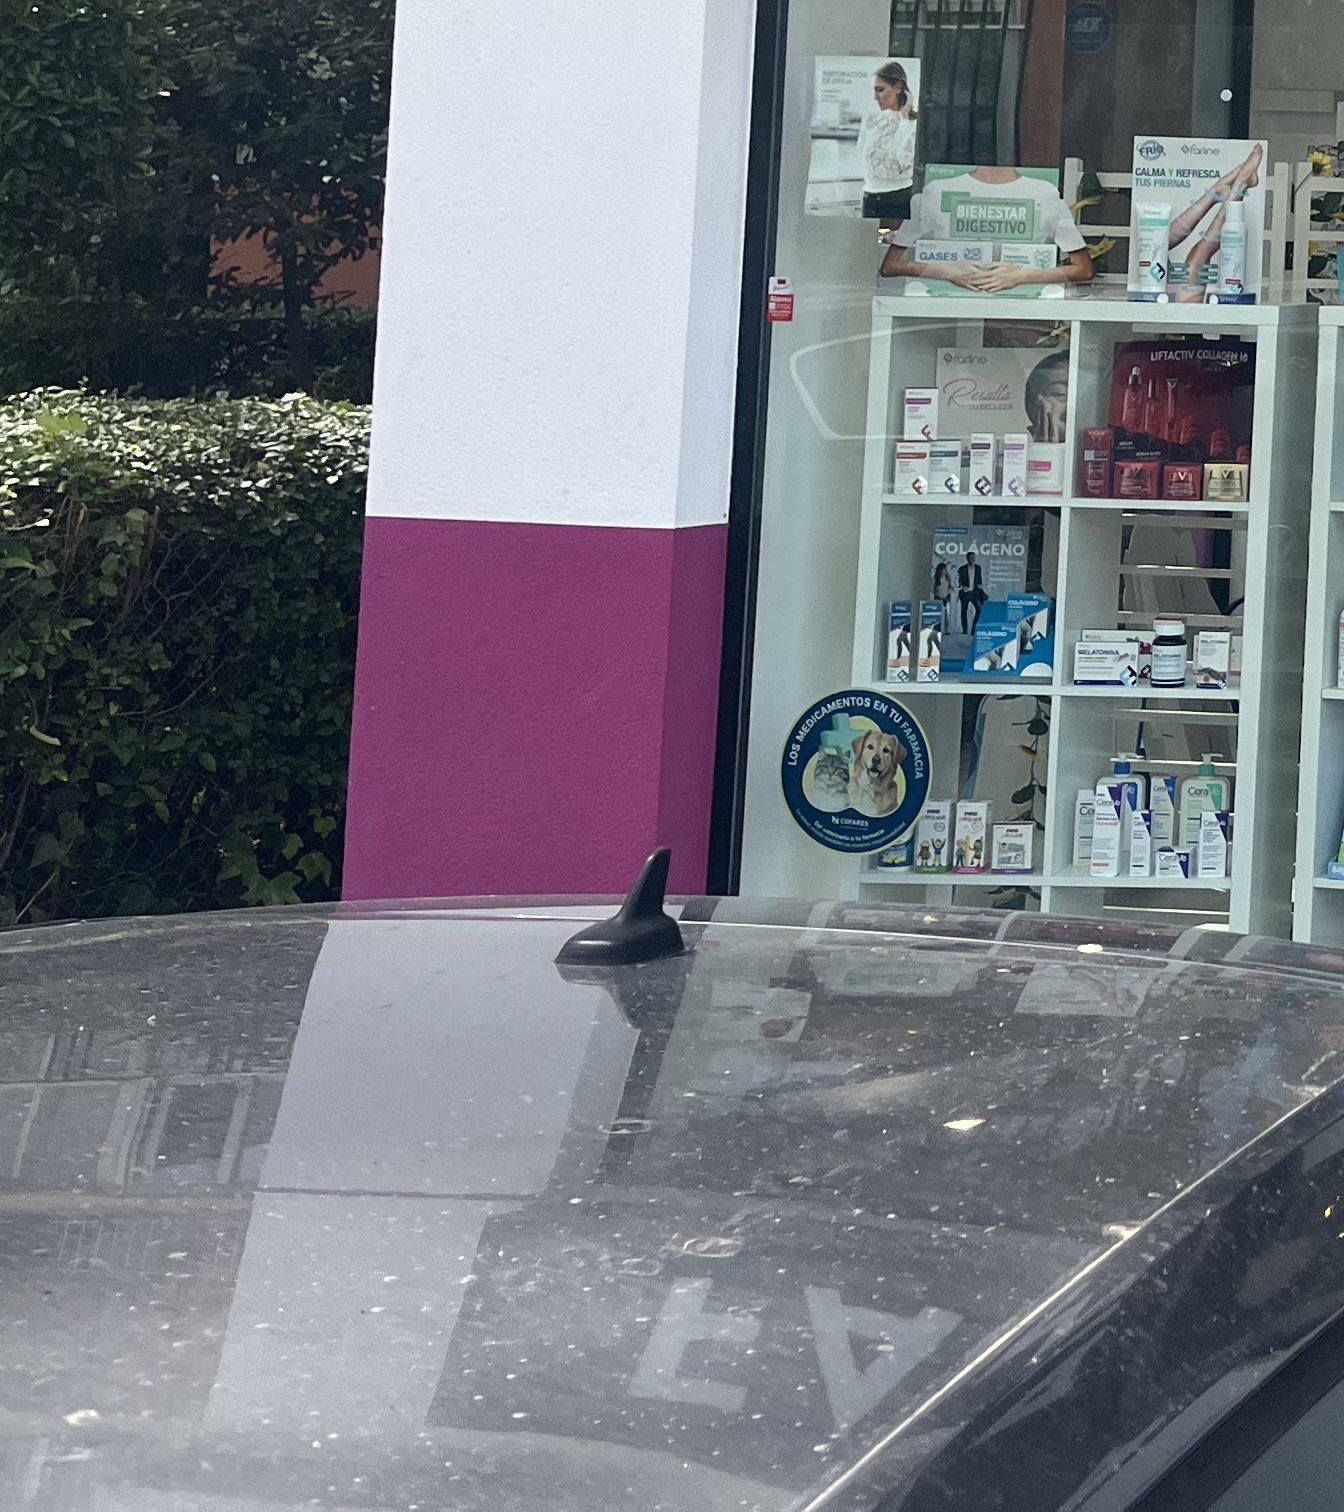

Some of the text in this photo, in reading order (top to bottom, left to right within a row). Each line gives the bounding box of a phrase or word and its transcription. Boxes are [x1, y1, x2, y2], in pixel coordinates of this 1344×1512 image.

[1135, 167, 1166, 178] CALMA
[1176, 168, 1221, 179] REFRESCA
[1135, 177, 1191, 188] TUS PIERNAS
[956, 204, 1026, 220] BIENESTAR
[955, 219, 1027, 235] DIGESTIVO
[919, 251, 959, 262] GASES
[1150, 349, 1195, 362] LIFTACTIV
[935, 540, 1026, 557] COLÁGENO
[788, 696, 924, 780] LOS MEDICAMENTOS EN TU FARMACIA
